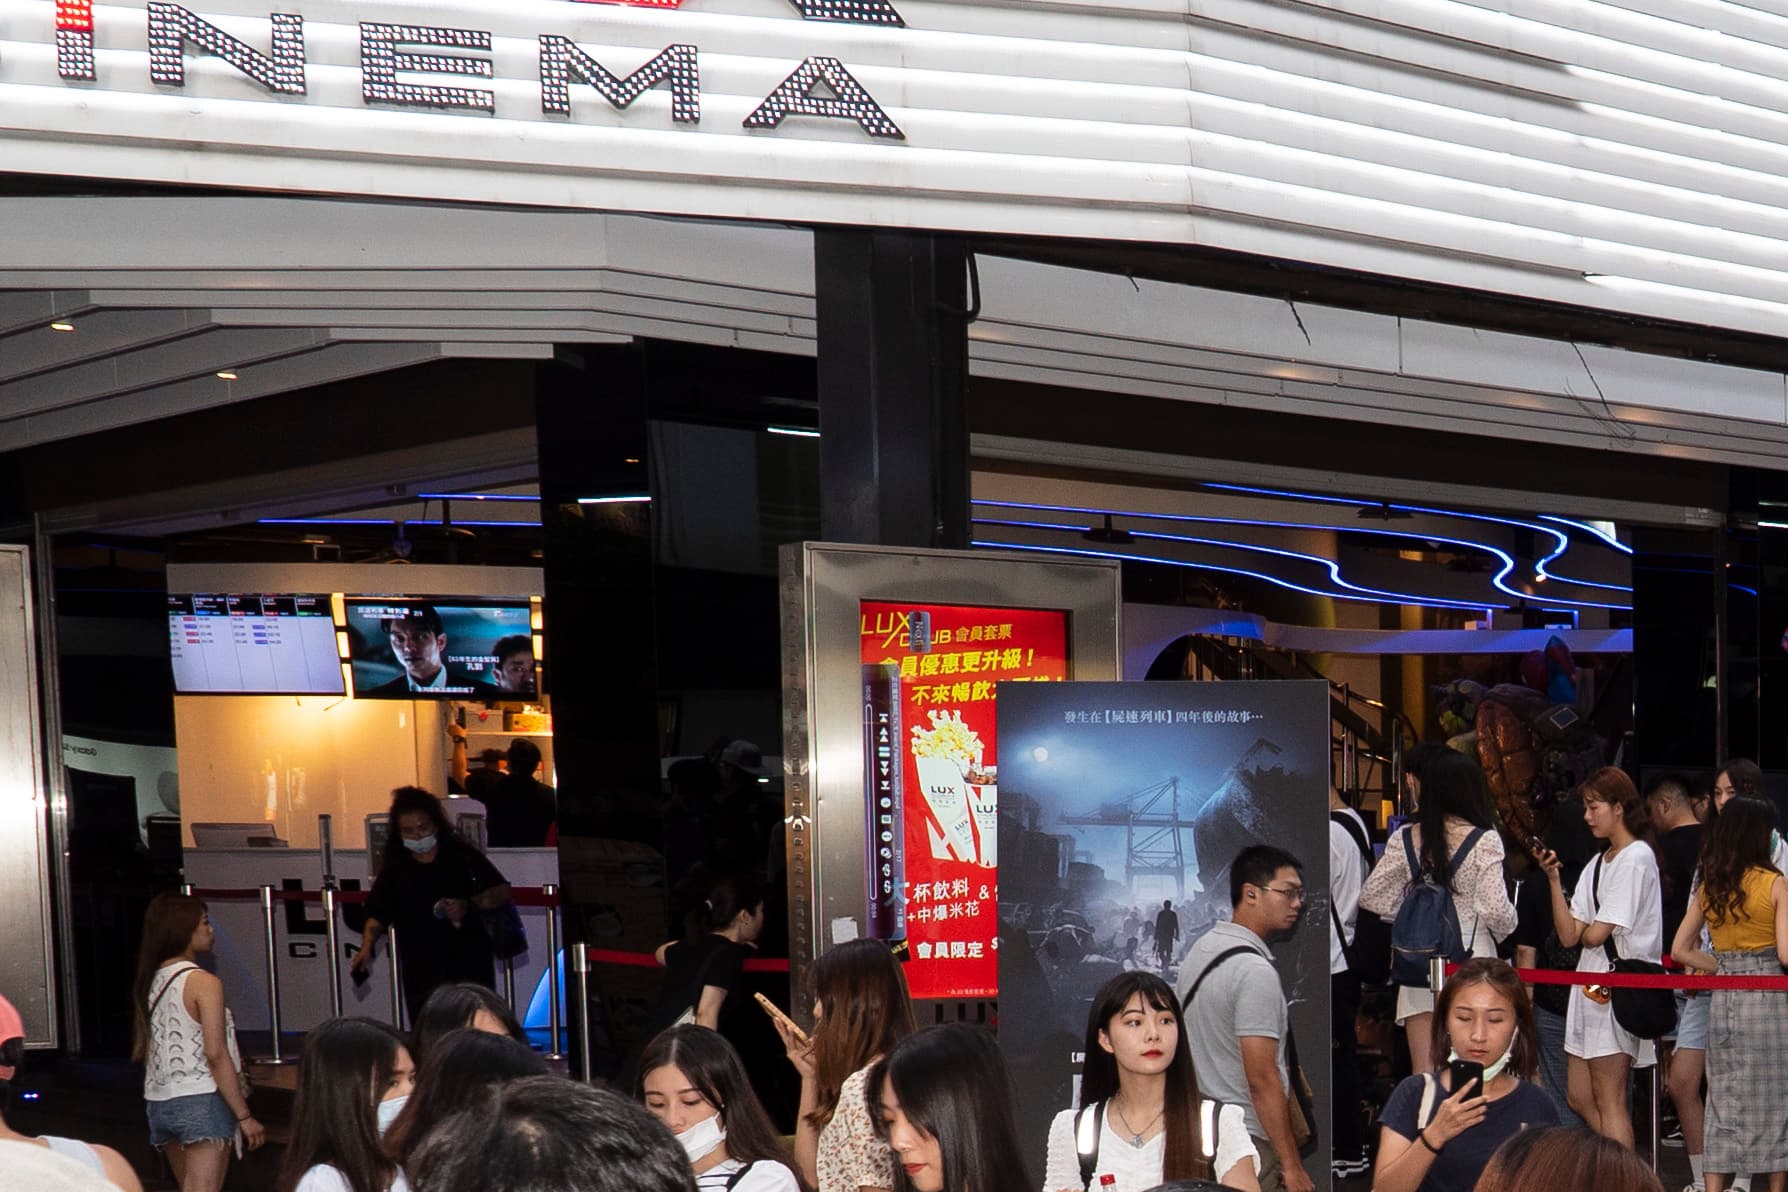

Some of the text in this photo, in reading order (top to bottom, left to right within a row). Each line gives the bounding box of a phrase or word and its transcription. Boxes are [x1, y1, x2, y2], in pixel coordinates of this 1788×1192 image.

[955, 624, 1013, 643] 會員套票
[930, 785, 955, 795] LUX
[917, 941, 984, 959] 會員限定
